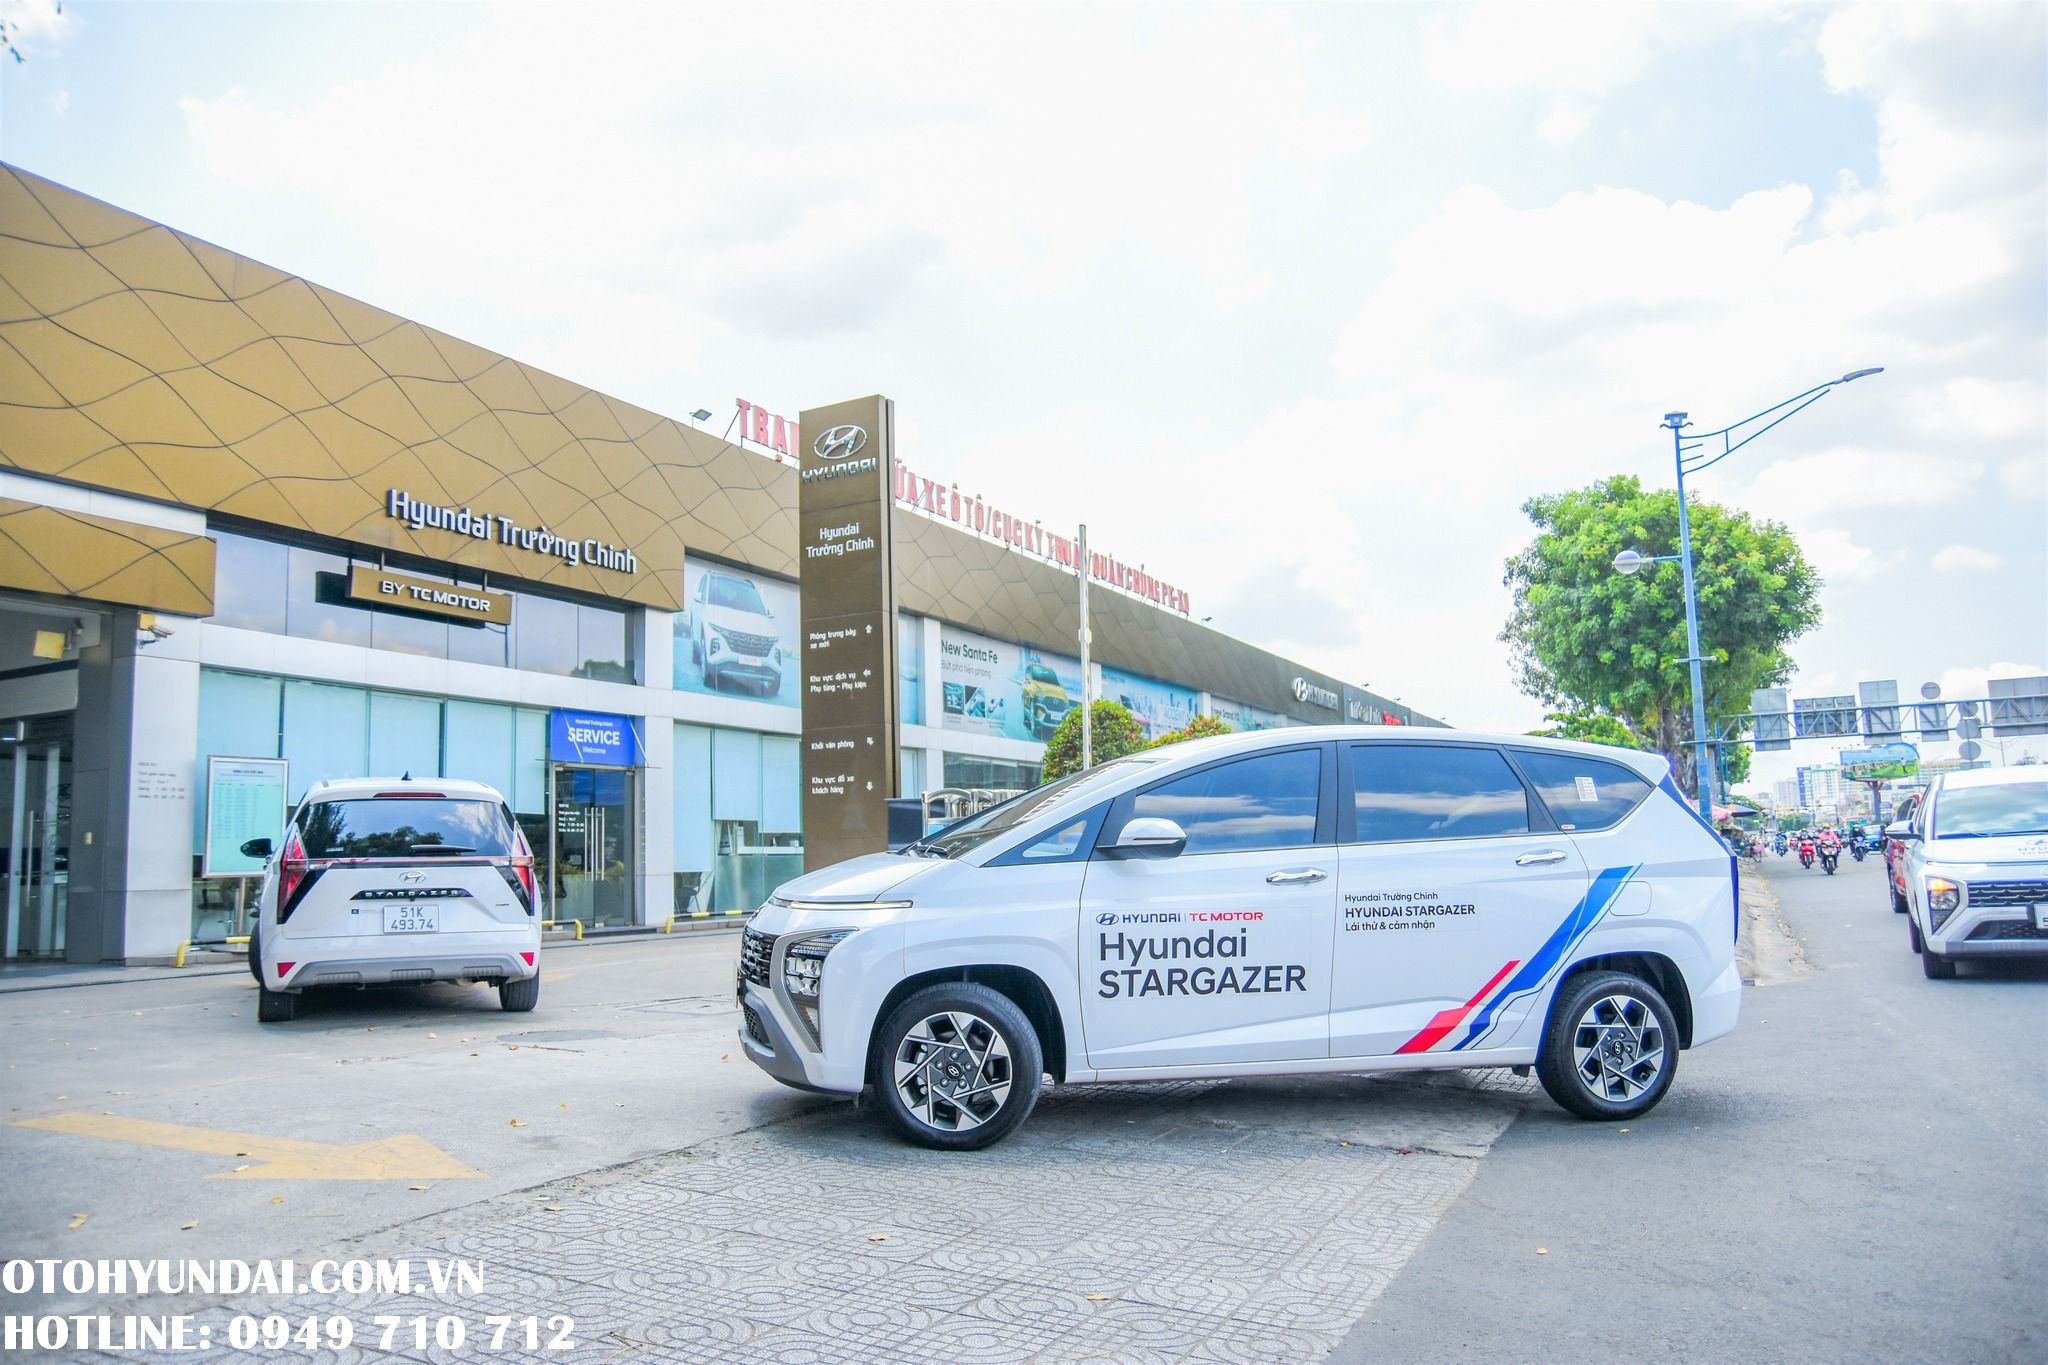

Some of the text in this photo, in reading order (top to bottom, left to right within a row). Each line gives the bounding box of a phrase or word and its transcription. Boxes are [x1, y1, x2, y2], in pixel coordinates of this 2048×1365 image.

[802, 458, 876, 483] HYUNDAI
[923, 478, 947, 517] XE
[387, 488, 637, 574] Hyundai Trường Chinh
[820, 522, 859, 541] Hyundai
[806, 537, 874, 558] Trường Chinh
[380, 580, 490, 612] BY TC MOTOR
[941, 640, 998, 664] New Santa Fe
[810, 675, 820, 683] Khu
[568, 727, 620, 745] SERVICE
[582, 746, 606, 754] Welcome
[812, 776, 823, 784] Khu
[365, 889, 459, 898] STARGAZER
[1344, 891, 1438, 903] Hyundai Trường Chinh
[401, 907, 423, 918] 51K
[1122, 912, 1264, 923] HYUNDAI TC MOTOR
[1345, 904, 1475, 918] HYUNDAI STARGAZER
[391, 919, 433, 931] 493.74
[1345, 920, 1435, 931] Lái thử & cảm nhận
[1100, 927, 1247, 967] Hyundai
[1098, 965, 1307, 999] STARGAZER
